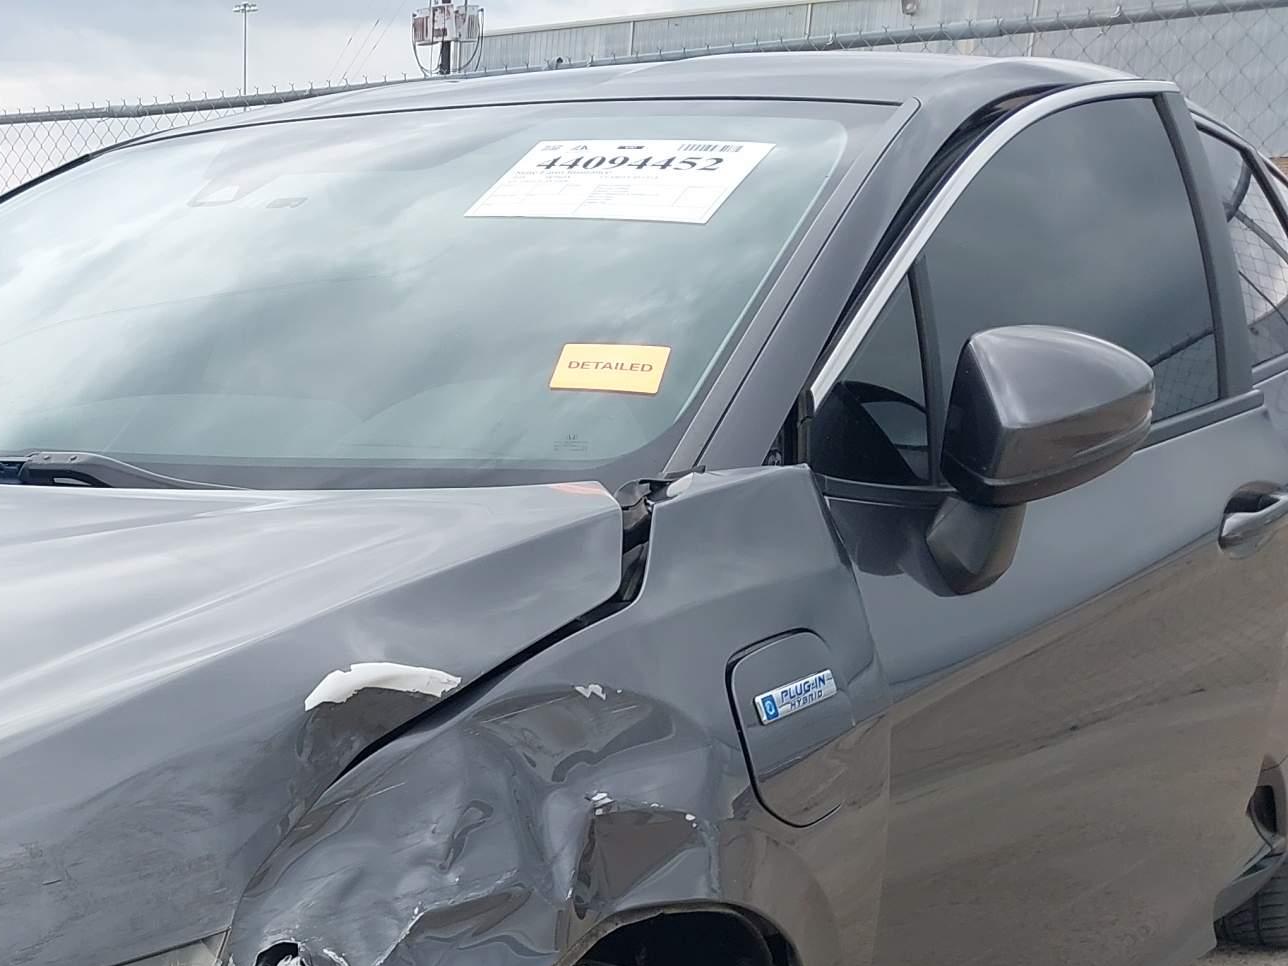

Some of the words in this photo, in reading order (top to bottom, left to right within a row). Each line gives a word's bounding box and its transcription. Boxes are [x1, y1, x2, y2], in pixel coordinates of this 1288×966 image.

[536, 155, 724, 171] 44094452
[567, 361, 653, 372] DETAILED
[780, 674, 826, 704] PLUG-IN
